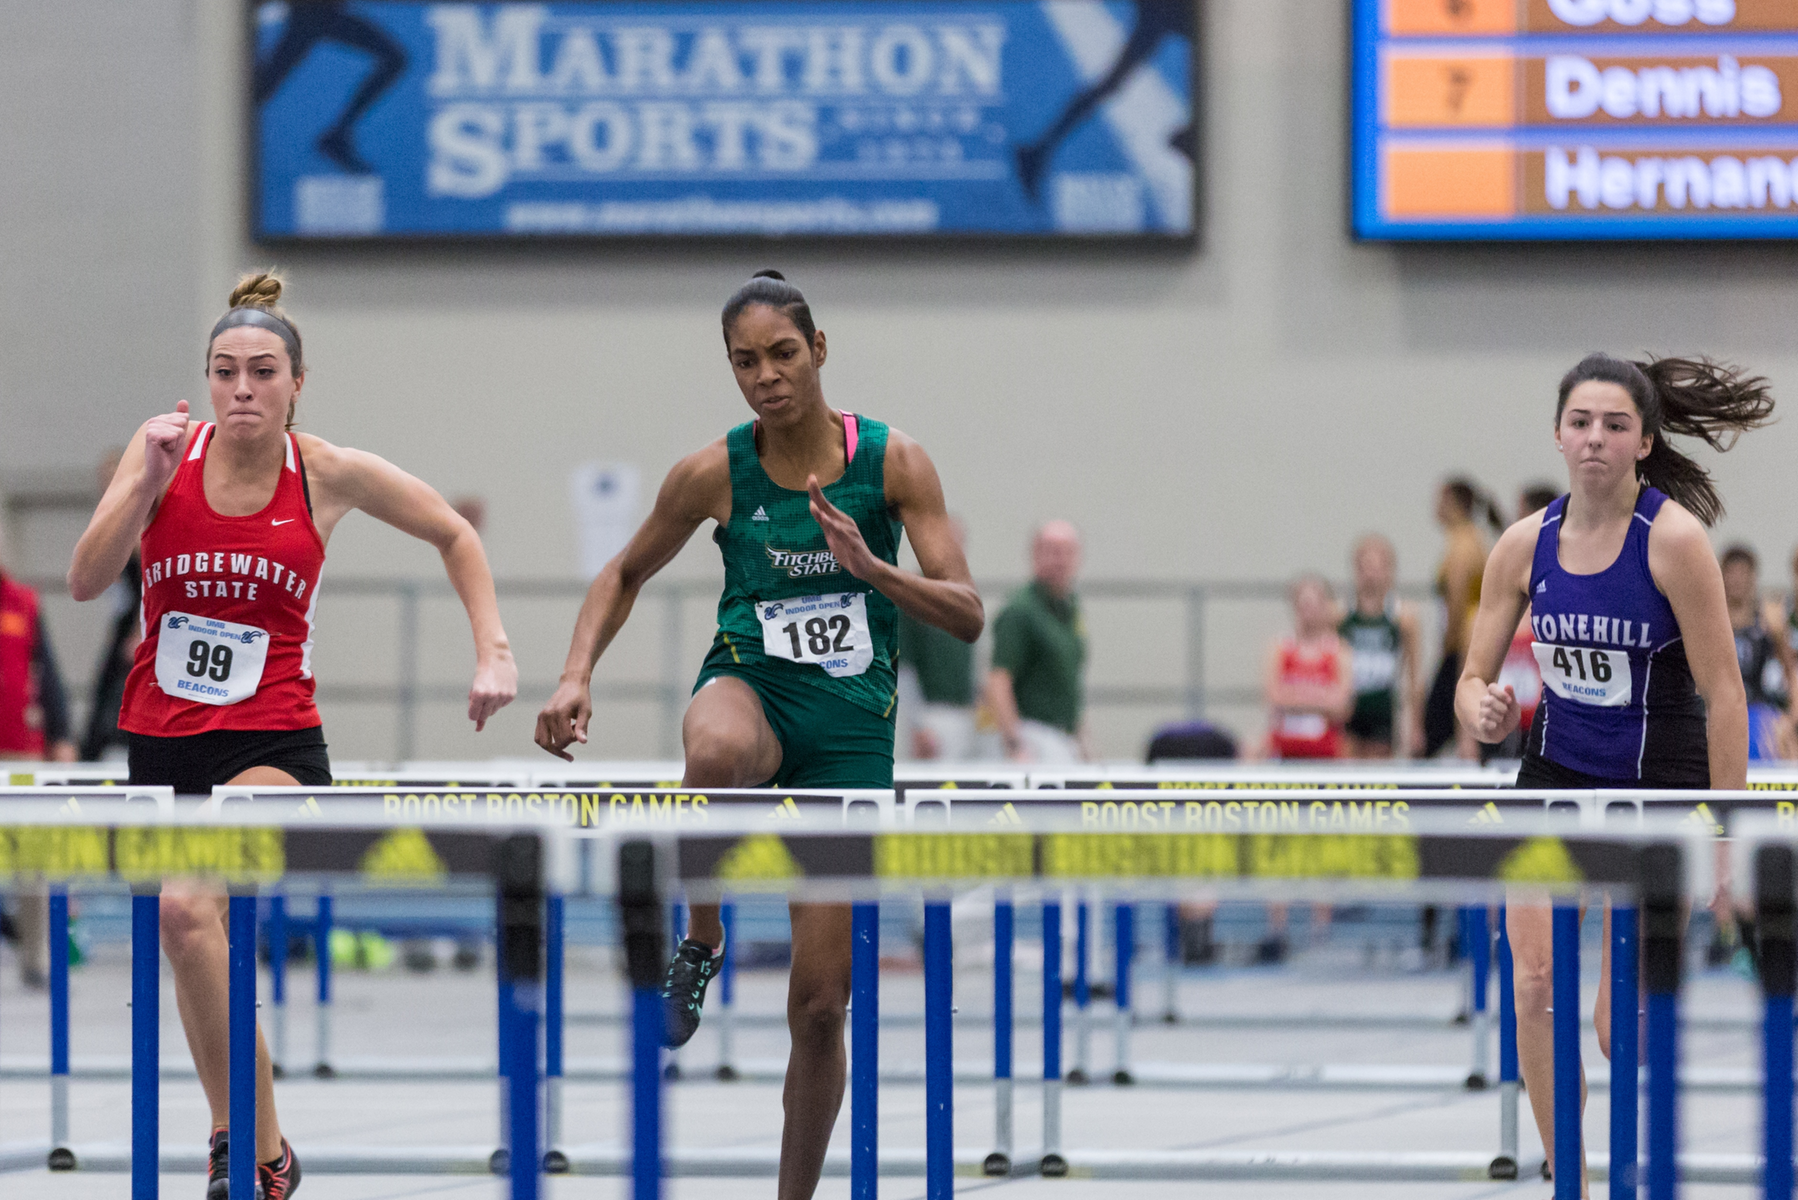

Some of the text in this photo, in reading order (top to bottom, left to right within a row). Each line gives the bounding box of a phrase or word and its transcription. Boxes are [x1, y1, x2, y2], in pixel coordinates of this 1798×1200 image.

[427, 2, 1006, 97] MARATHON
[1546, 54, 1782, 119] Dennis
[427, 101, 818, 196] SPORTS
[1546, 144, 1798, 210] Hernan
[145, 552, 307, 600] BRIDGEWATER
[789, 562, 839, 577] STATE
[184, 580, 258, 601] STATE
[785, 600, 840, 615] INDOOR OPEN
[188, 624, 241, 641] INDOOR OPEN
[206, 619, 225, 630] UMB
[782, 614, 854, 659] 182
[1532, 613, 1652, 648] TONEHILL
[186, 639, 233, 683] 99
[1552, 647, 1612, 683] 416
[177, 679, 229, 697] BEACONS
[486, 793, 600, 827] BOSTON
